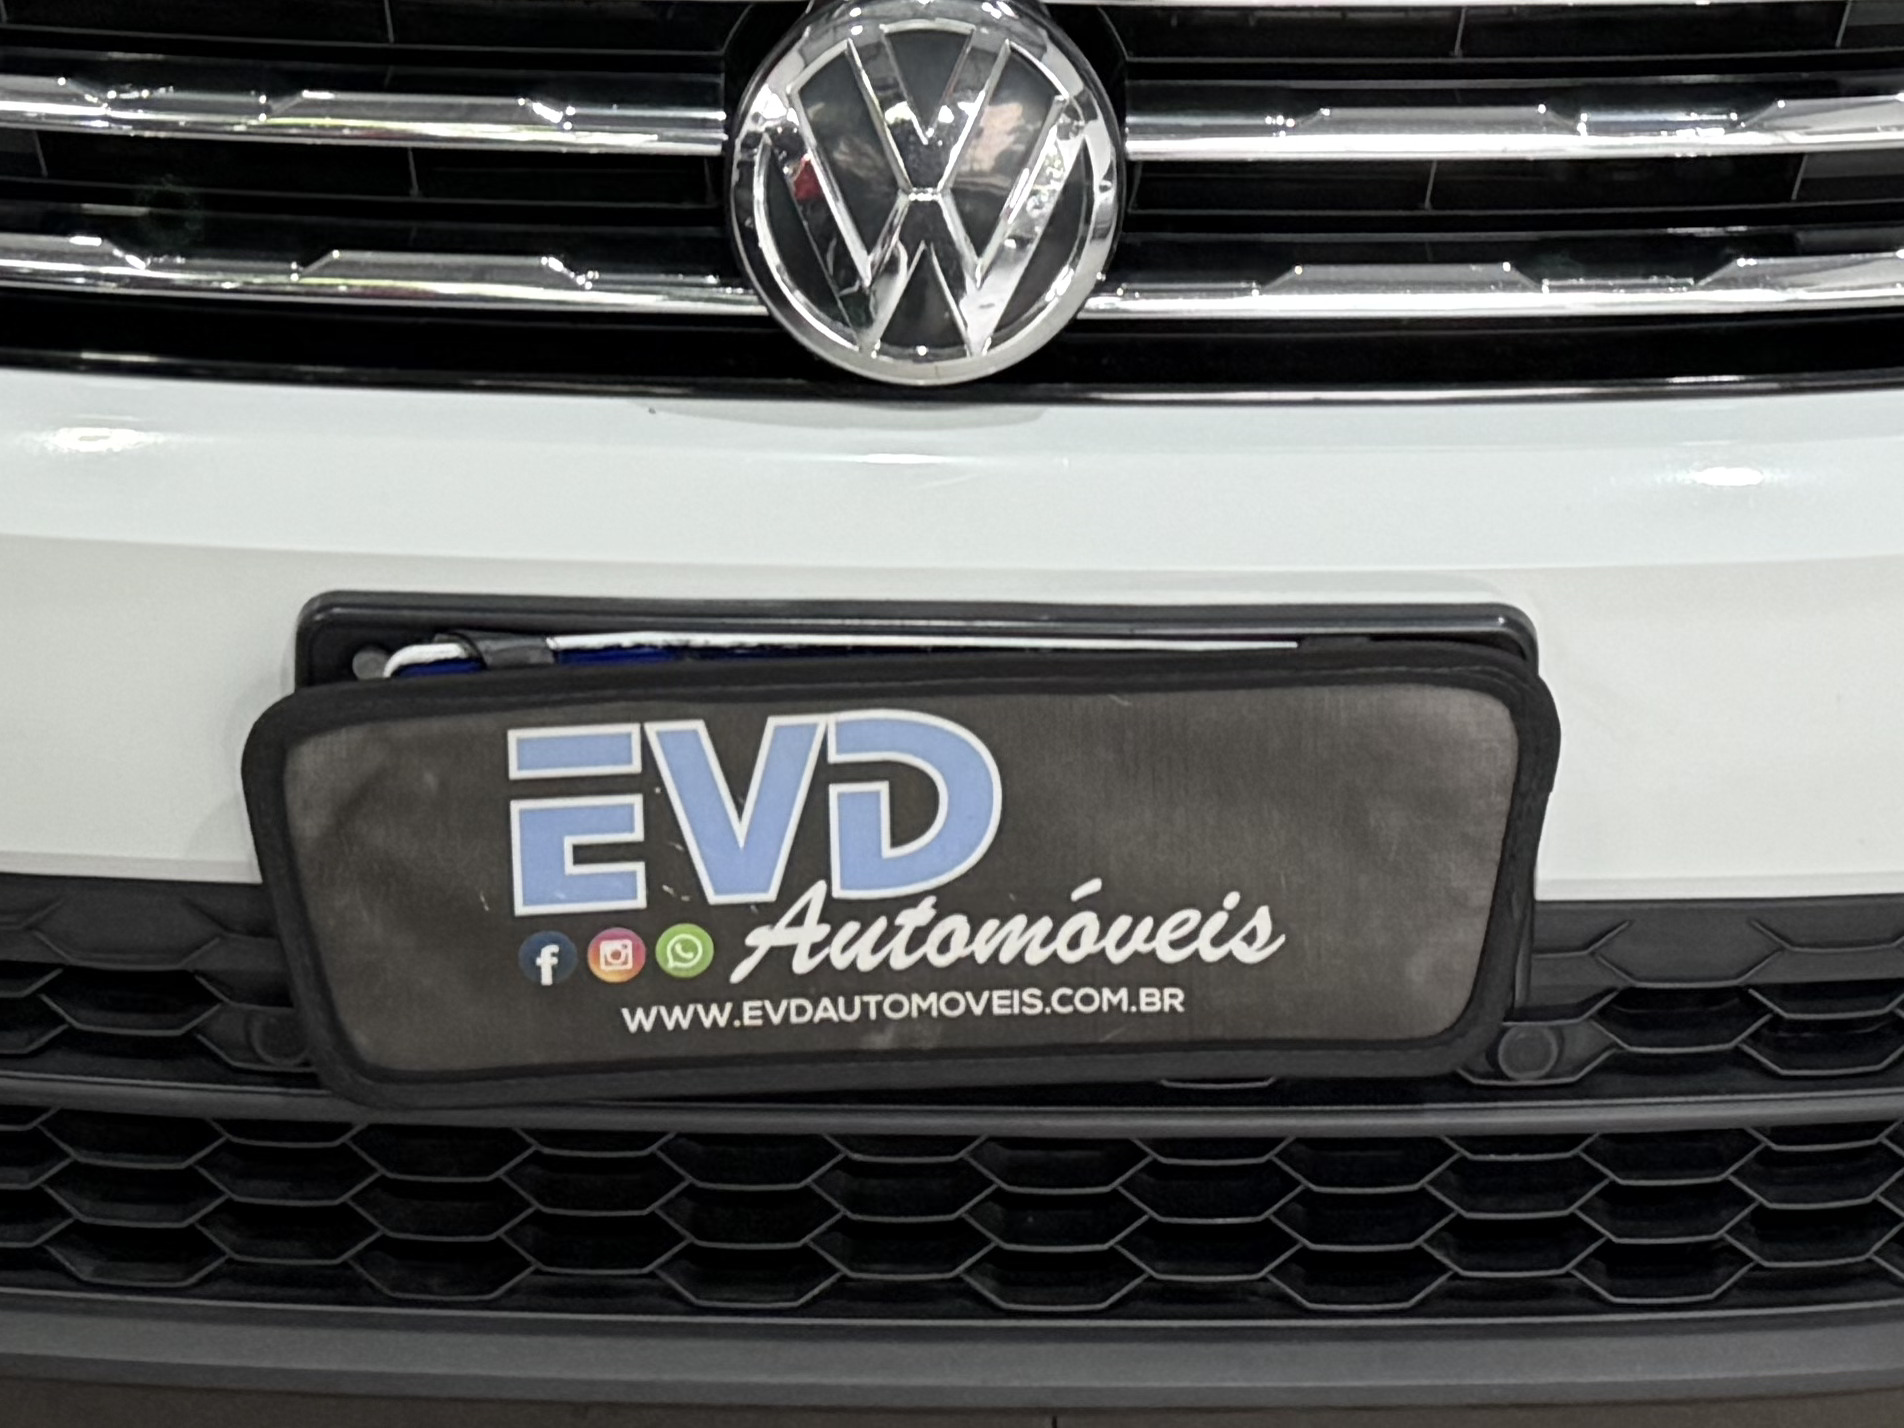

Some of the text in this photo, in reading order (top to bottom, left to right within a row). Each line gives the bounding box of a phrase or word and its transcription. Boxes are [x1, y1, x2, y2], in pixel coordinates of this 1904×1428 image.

[507, 708, 1003, 916] EVD
[729, 877, 1287, 984] Automóveis
[621, 986, 1186, 1034] WWW.EVDAUTOMOVEIS.COM.BR
